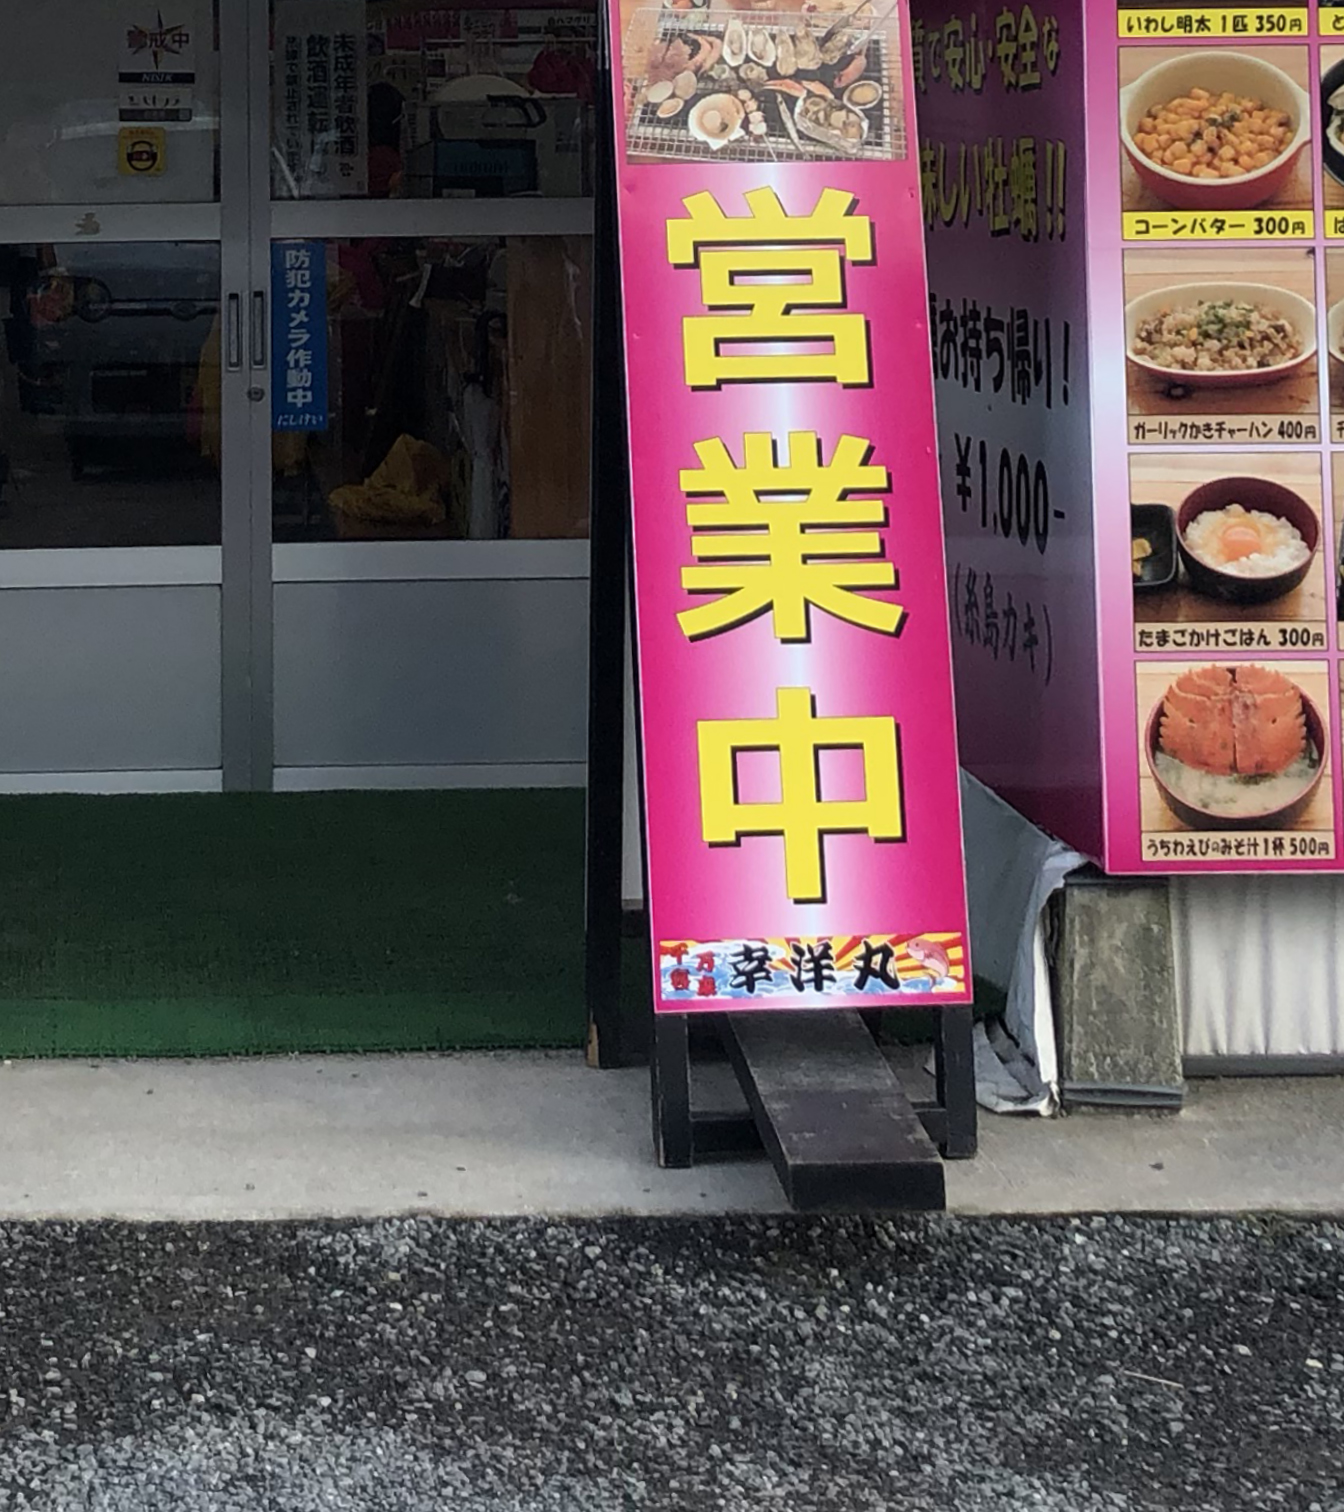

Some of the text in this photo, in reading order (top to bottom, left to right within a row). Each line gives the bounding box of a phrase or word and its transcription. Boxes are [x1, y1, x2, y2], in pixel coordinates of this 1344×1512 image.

[1125, 14, 1303, 38] いわし明太 1匹 350円
[333, 33, 357, 156] 未成年者飲酒
[1133, 216, 1306, 235] コーンバター 300円
[285, 250, 314, 408] 防犯カメラ作動中
[276, 411, 324, 427] にしけい
[1133, 420, 1317, 440] ガーリックかきチャーハン 400円
[666, 185, 908, 904] 営業中
[1137, 627, 1325, 648] たまごかけごはん 300円
[1146, 837, 1261, 862] うちわえびのみそ汁
[1289, 837, 1330, 861] 500円
[730, 938, 902, 993] 幸洋丸
